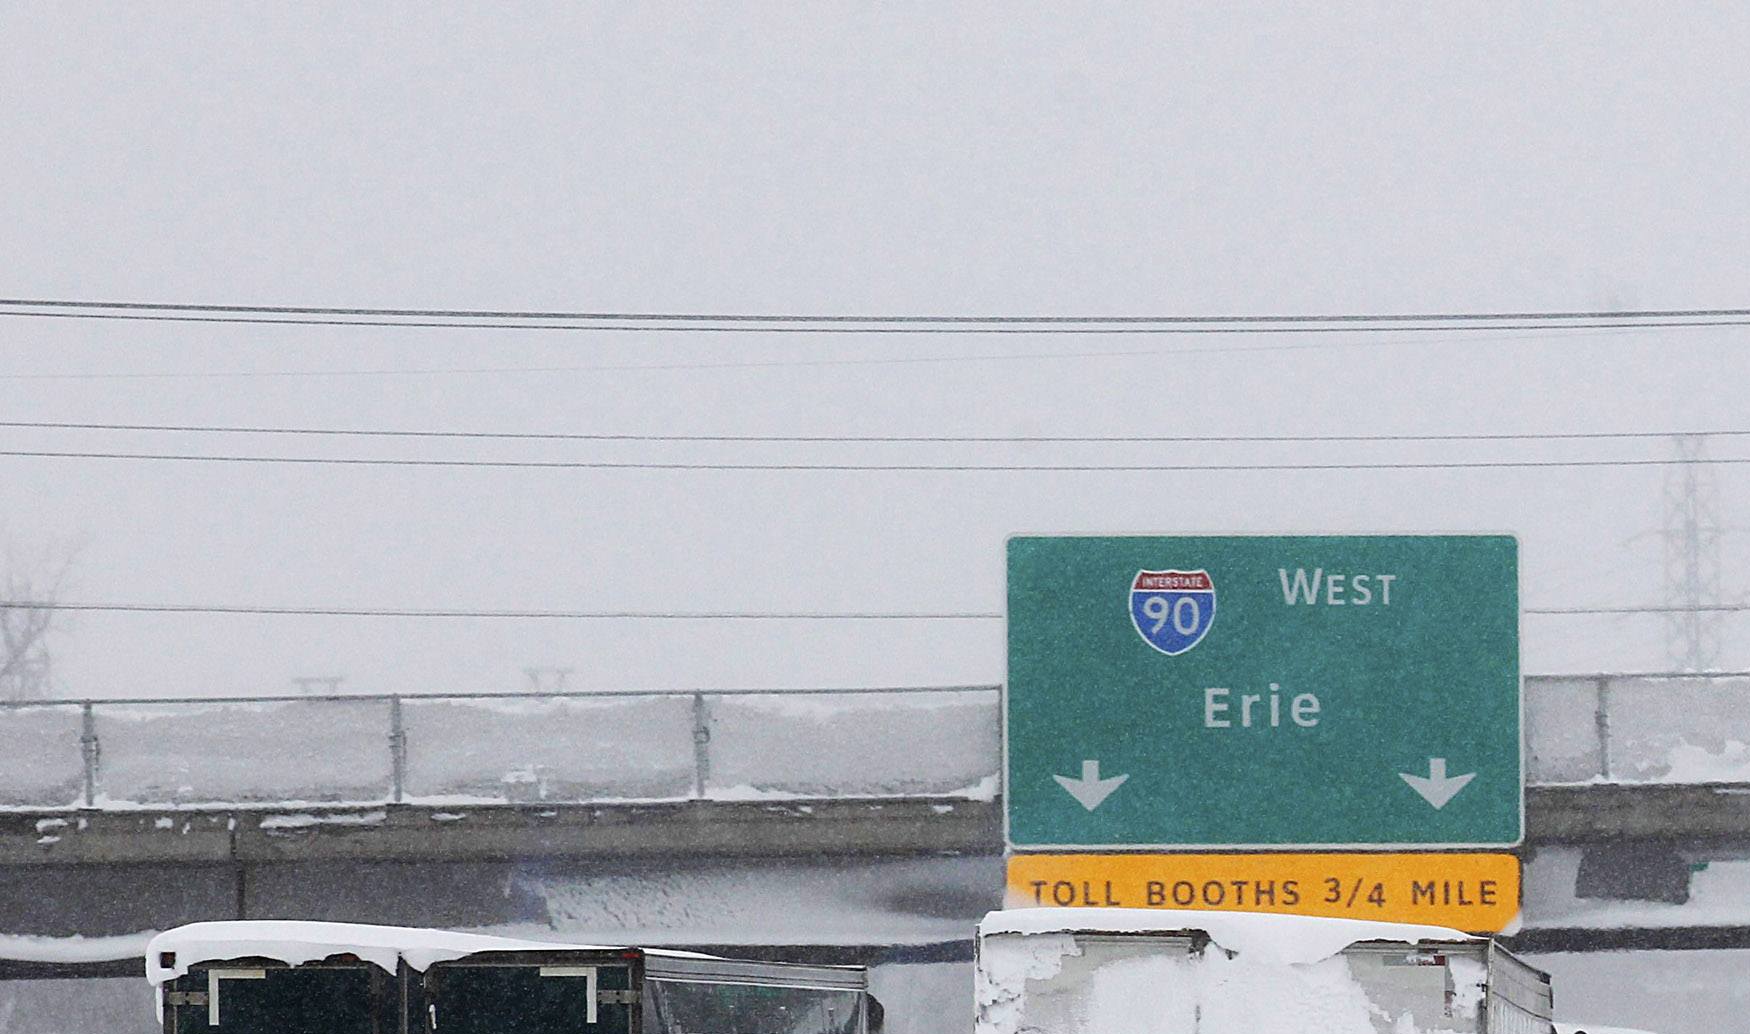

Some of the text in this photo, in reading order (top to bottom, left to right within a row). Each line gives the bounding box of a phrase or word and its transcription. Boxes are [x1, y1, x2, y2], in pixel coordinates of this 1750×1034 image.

[1142, 576, 1203, 588] INTERSTATE
[1279, 569, 1397, 606] WEST
[1143, 596, 1199, 636] 90
[1205, 683, 1321, 728] Erie
[1031, 877, 1498, 908] TOLL BOOTHS 3/4 MILE
